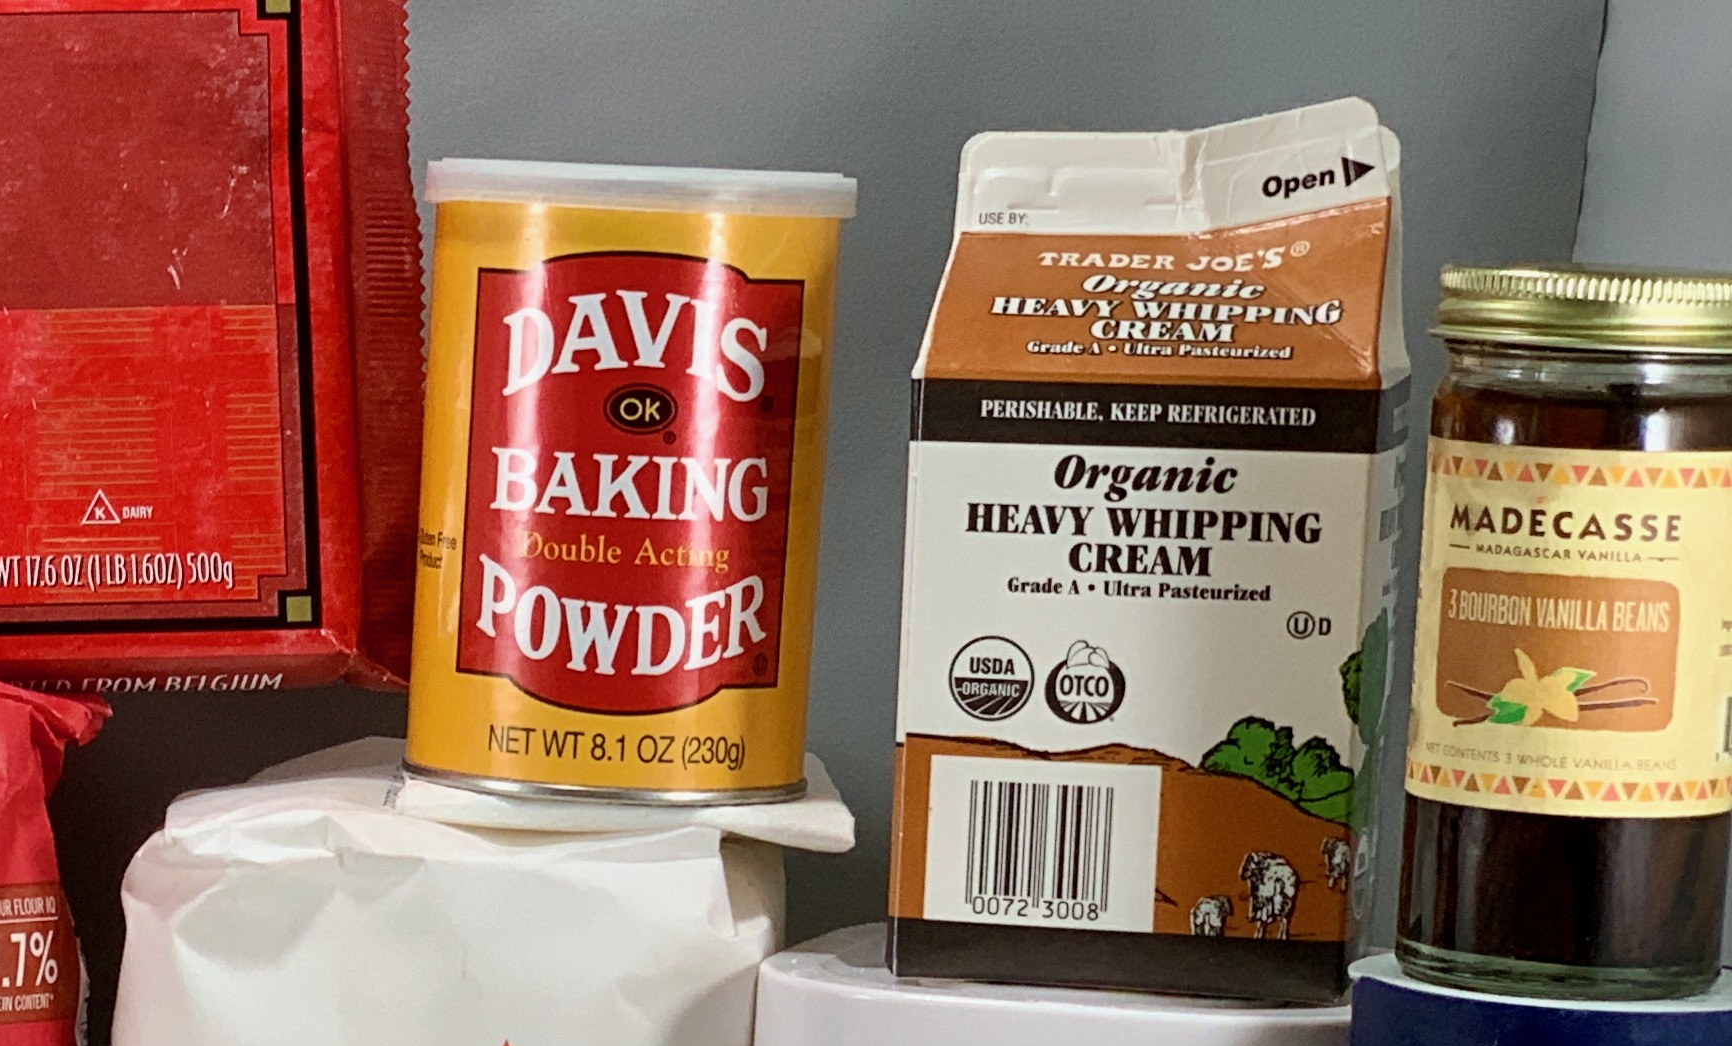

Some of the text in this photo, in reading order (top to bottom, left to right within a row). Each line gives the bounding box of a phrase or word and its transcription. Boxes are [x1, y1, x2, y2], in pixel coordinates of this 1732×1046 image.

[1261, 166, 1335, 199] Open
[1036, 251, 1175, 270] TRADER
[1082, 273, 1266, 300] Organic
[990, 296, 1343, 326] HEAVY WHIPPING
[502, 289, 767, 403] DAVIS
[1090, 319, 1235, 343] CREAM
[980, 399, 1317, 427] PERISHABLE, KEEP REFRIGERATED
[489, 445, 768, 523] BAKING
[1053, 454, 1238, 503] Organic
[965, 503, 1323, 544] HEAVY WHIPPING
[520, 529, 730, 573] Double Acting
[1068, 543, 1213, 577] CREAM
[1476, 544, 1643, 562] MADAGASCAR VANILLA
[26, 553, 58, 587] 17.6
[61, 553, 85, 586] OZ
[105, 553, 127, 586] LB
[187, 551, 234, 590] 500g
[475, 553, 767, 678] POWDER
[1448, 589, 1670, 633] 3 BOURBON VANILLA BEANS
[969, 656, 1016, 677] USDA
[961, 681, 1021, 699] ORGANIC
[1058, 675, 1110, 697] OTCO
[488, 725, 746, 770] NET WT 8.1 OZ (230g)
[972, 895, 1100, 922] 0072 3008
